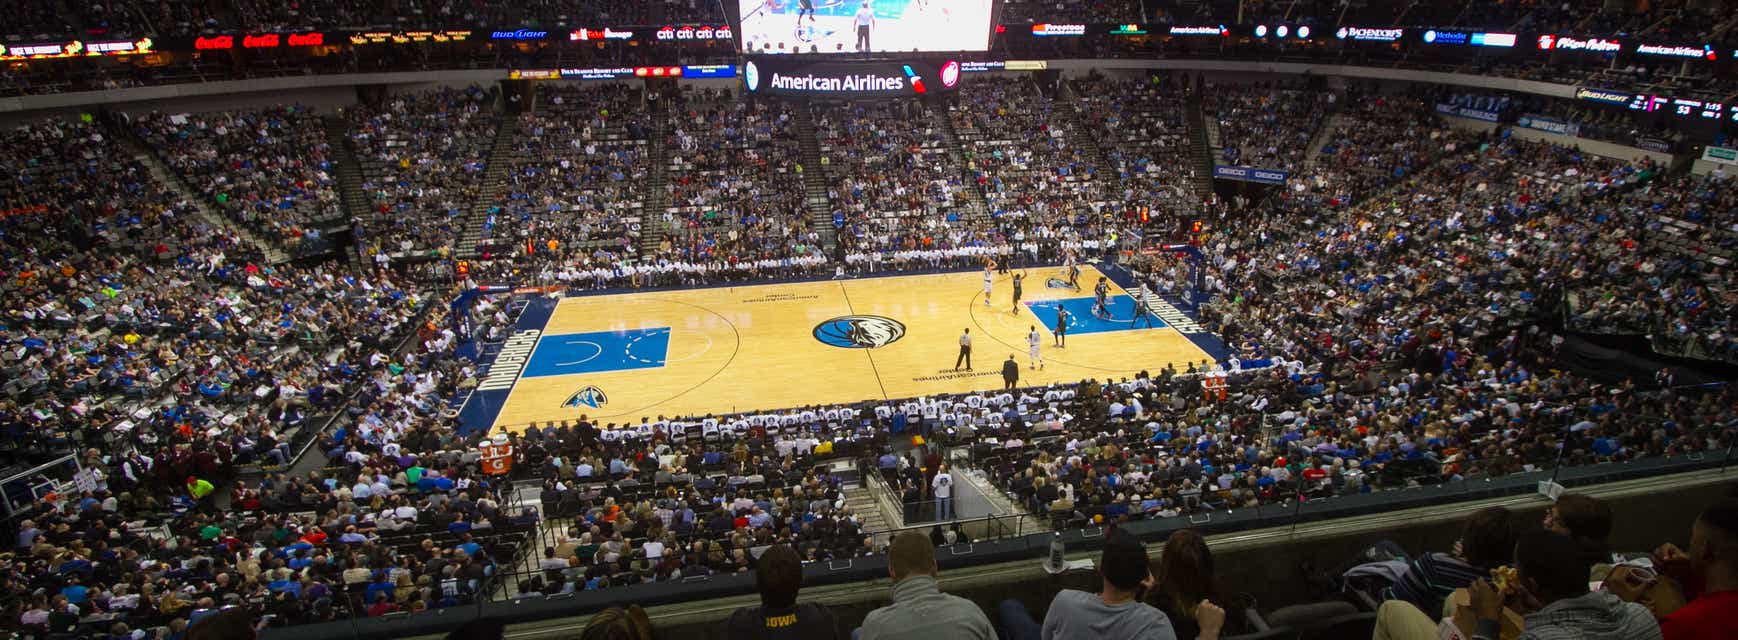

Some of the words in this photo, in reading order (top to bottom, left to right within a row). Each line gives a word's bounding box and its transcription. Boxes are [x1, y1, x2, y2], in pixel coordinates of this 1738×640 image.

[657, 30, 674, 39] citi
[677, 29, 694, 39] citi
[696, 29, 714, 39] citi
[716, 29, 733, 39] citi
[1637, 44, 1673, 55] American
[1673, 46, 1704, 57] Airlines
[771, 73, 841, 90] American
[842, 74, 903, 91] Airlines
[1218, 167, 1246, 176] GEICO
[1255, 171, 1283, 180] GEICO
[477, 329, 541, 391] MAVERICKS
[766, 613, 797, 628] IOWA
